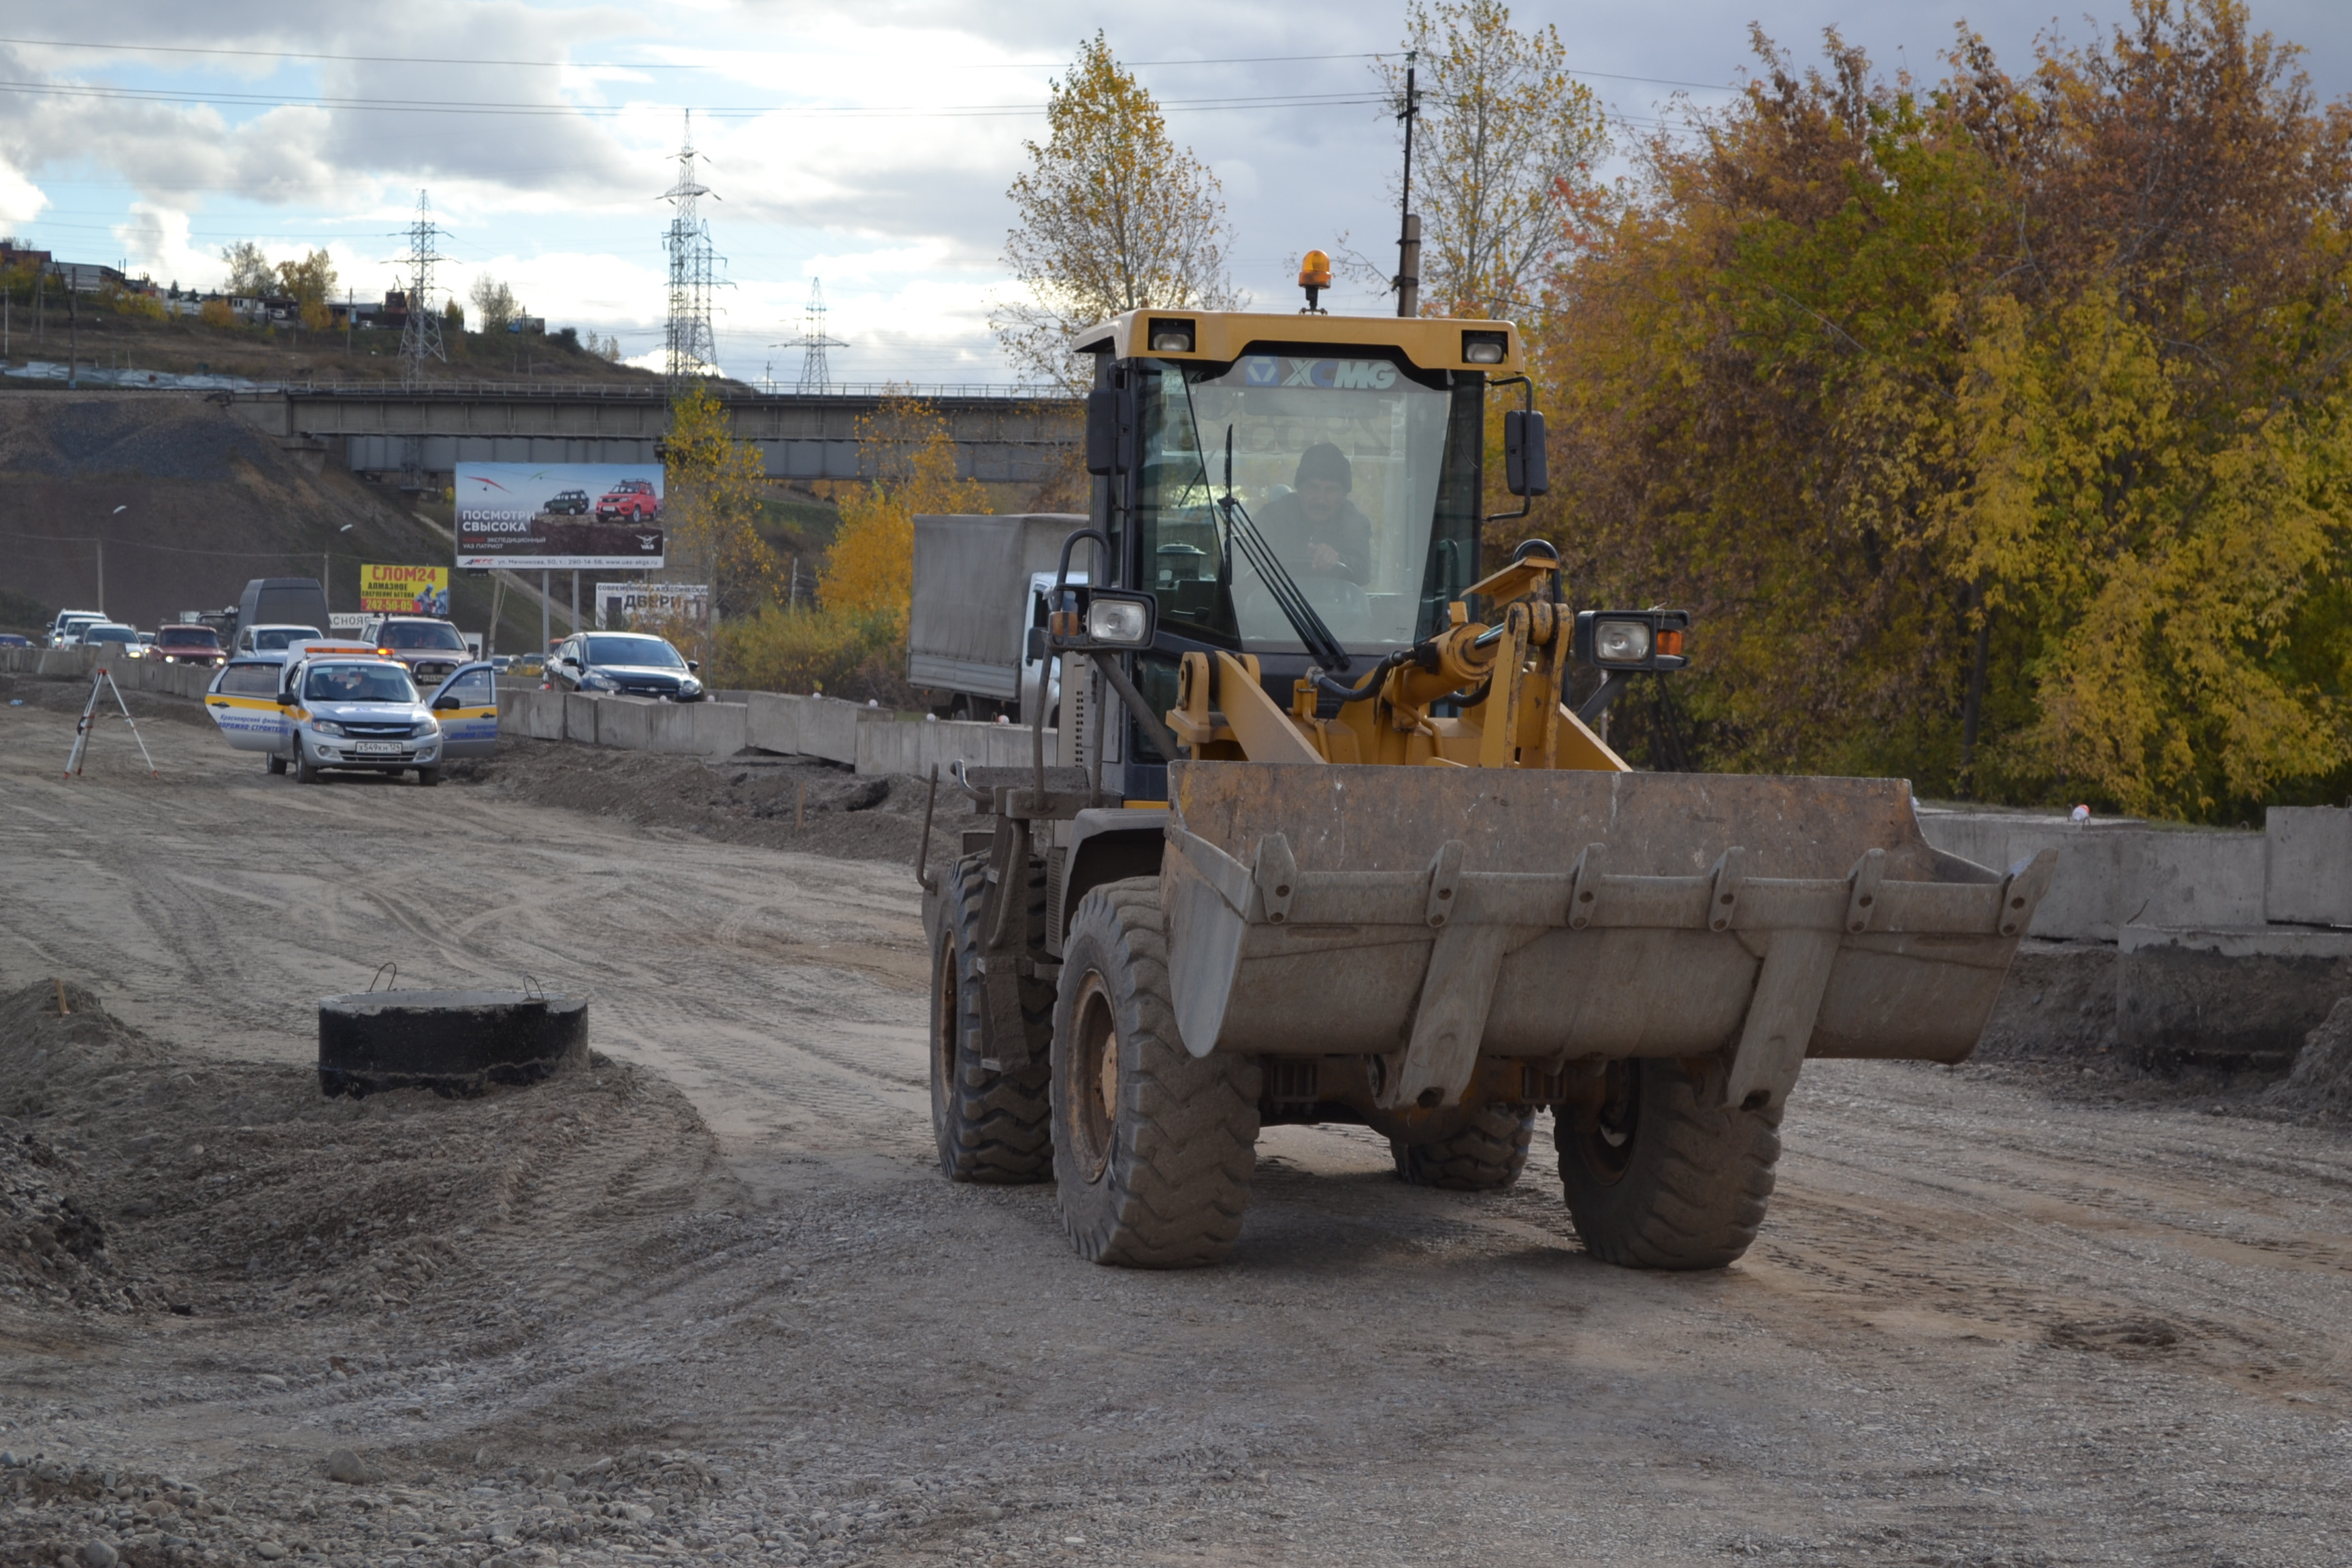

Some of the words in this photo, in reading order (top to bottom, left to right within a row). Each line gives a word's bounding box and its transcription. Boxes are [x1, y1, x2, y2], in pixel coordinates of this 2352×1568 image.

[1281, 359, 1396, 389] XCMG
[462, 510, 536, 521] ПОСМОТРИ
[463, 521, 527, 532] СВЫСОКА
[372, 566, 436, 582] СЛОМ24
[368, 582, 408, 591] АЛМАЗНОЕ
[366, 600, 412, 611] 242-50-05
